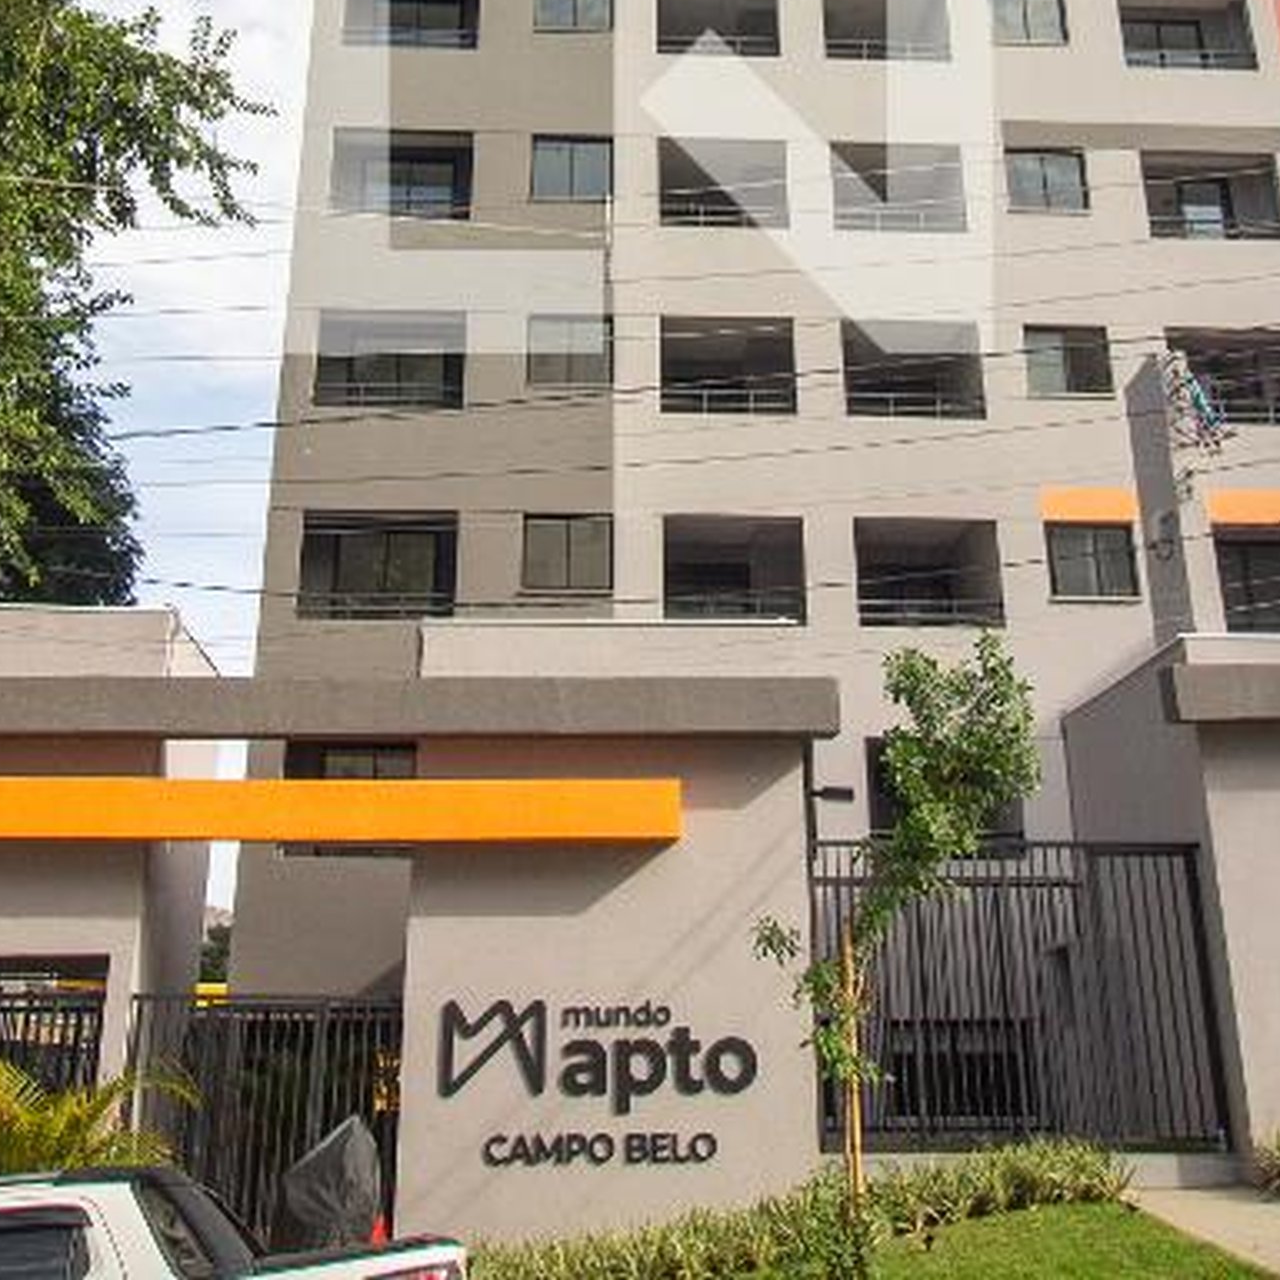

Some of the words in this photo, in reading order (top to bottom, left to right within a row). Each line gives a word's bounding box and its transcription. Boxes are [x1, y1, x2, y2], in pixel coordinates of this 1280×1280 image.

[560, 1000, 671, 1028] mundo
[559, 1027, 759, 1115] apto
[482, 1132, 615, 1167] CAMPO
[625, 1131, 718, 1165] BELO
